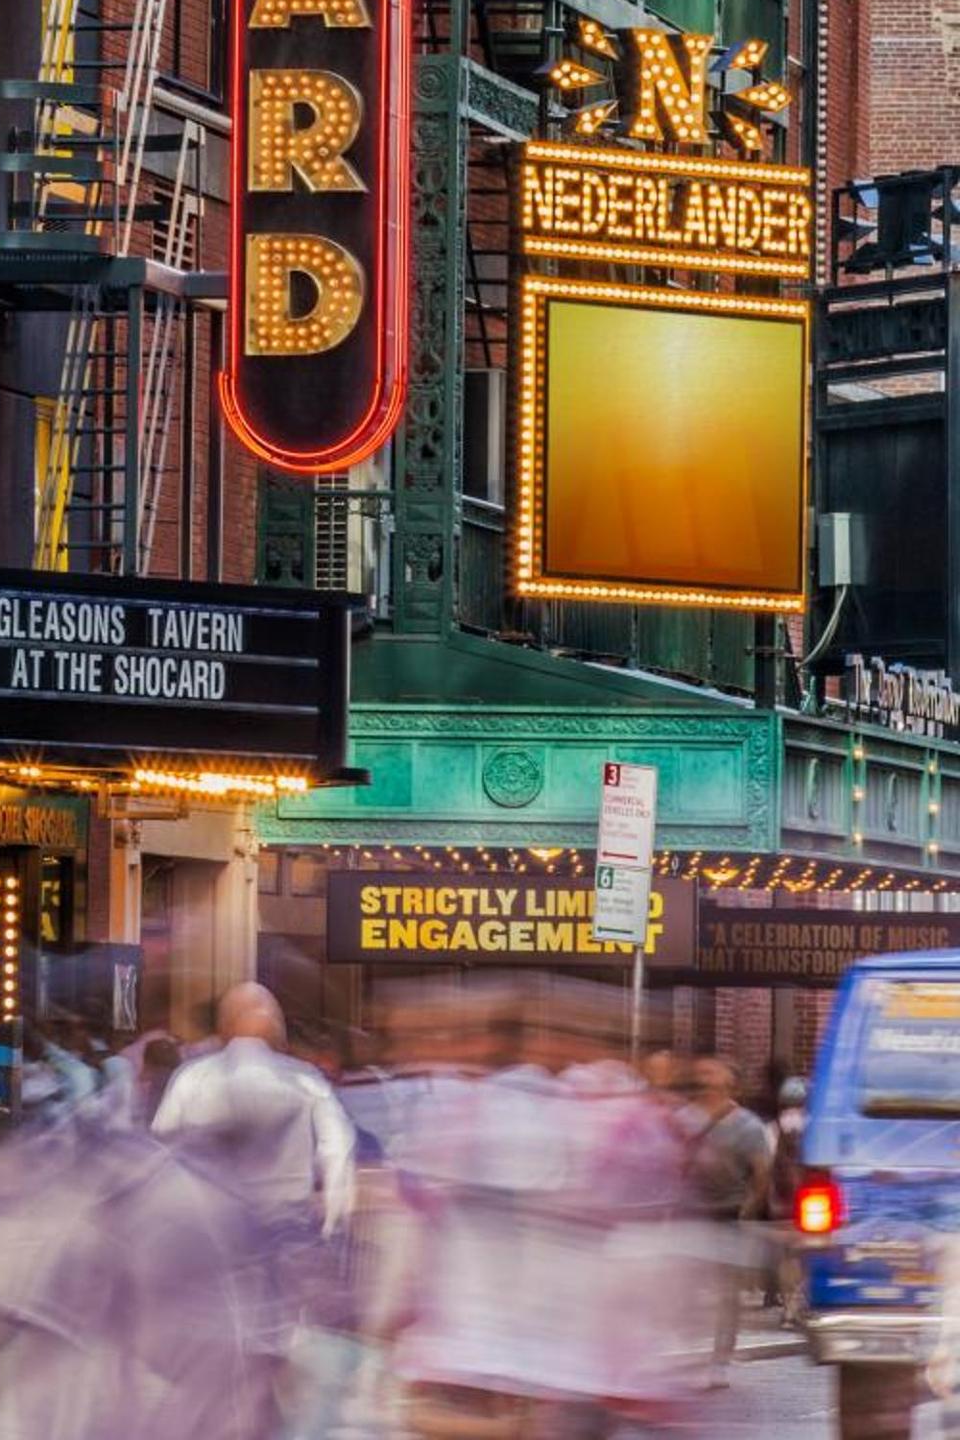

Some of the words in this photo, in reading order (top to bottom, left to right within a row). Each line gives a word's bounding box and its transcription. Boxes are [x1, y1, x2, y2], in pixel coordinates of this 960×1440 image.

[629, 27, 715, 144] N
[522, 164, 810, 255] NEDERLANDER
[148, 608, 244, 652] TAVERN
[11, 648, 44, 688] AT
[54, 651, 102, 692] THE
[113, 654, 225, 700] SHOCARD
[607, 765, 618, 784] 3
[601, 868, 611, 889] 6
[360, 886, 519, 916] STRICTLY
[526, 889, 664, 918] LIMID
[731, 923, 855, 949] CELEBRATION
[860, 925, 882, 950] OF
[697, 948, 735, 972] HAT
